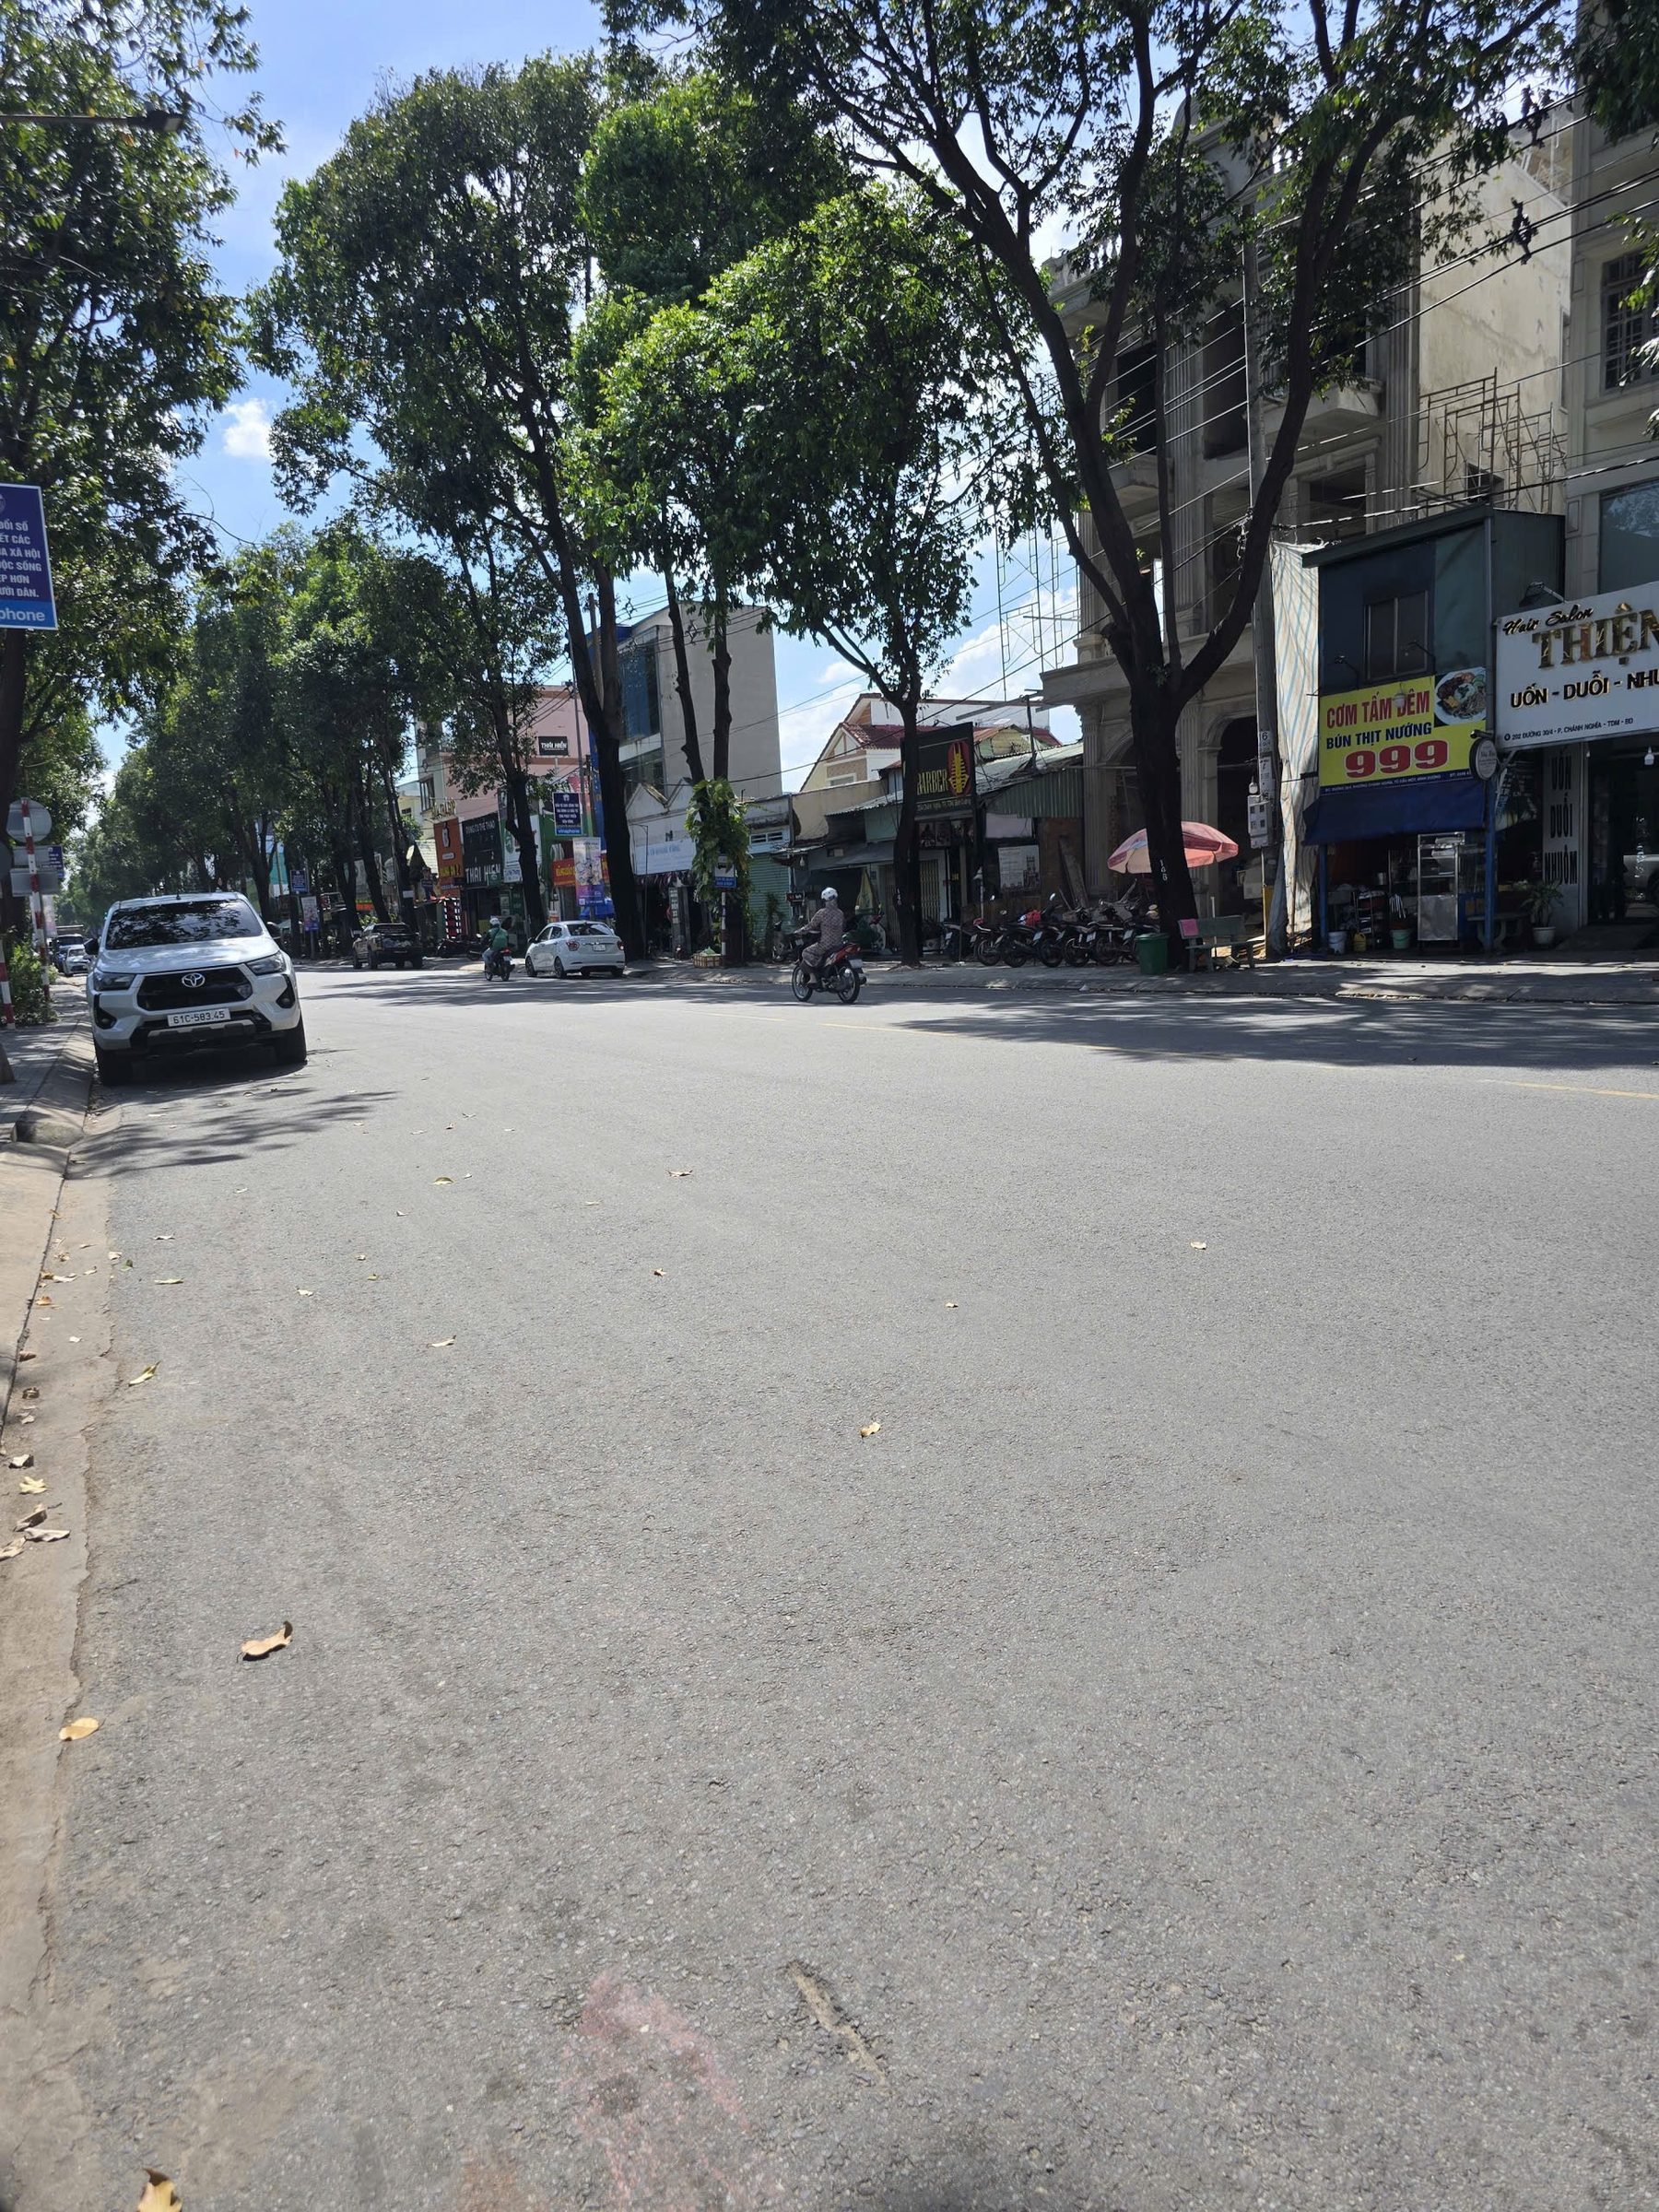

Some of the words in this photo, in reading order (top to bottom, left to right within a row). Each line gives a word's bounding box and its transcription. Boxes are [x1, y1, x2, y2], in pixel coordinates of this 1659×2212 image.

[0, 559, 14, 571] ỘC
[16, 560, 42, 571] SỐNG
[24, 548, 41, 559] HỘI
[1502, 618, 1540, 636] Hair
[1545, 604, 1594, 627] Salon
[1511, 682, 1548, 709] UỐN
[1563, 670, 1609, 700] DUỖI
[1326, 702, 1358, 729] CƠM
[1361, 691, 1392, 724] TẤM
[1326, 732, 1351, 749] BÚN
[1356, 729, 1382, 747] THỊT
[1385, 722, 1431, 741] NƯỚNG
[1563, 724, 1583, 734] CHÁNH
[1345, 739, 1449, 779] 999
[173, 1010, 225, 1024] 61C-583.45
